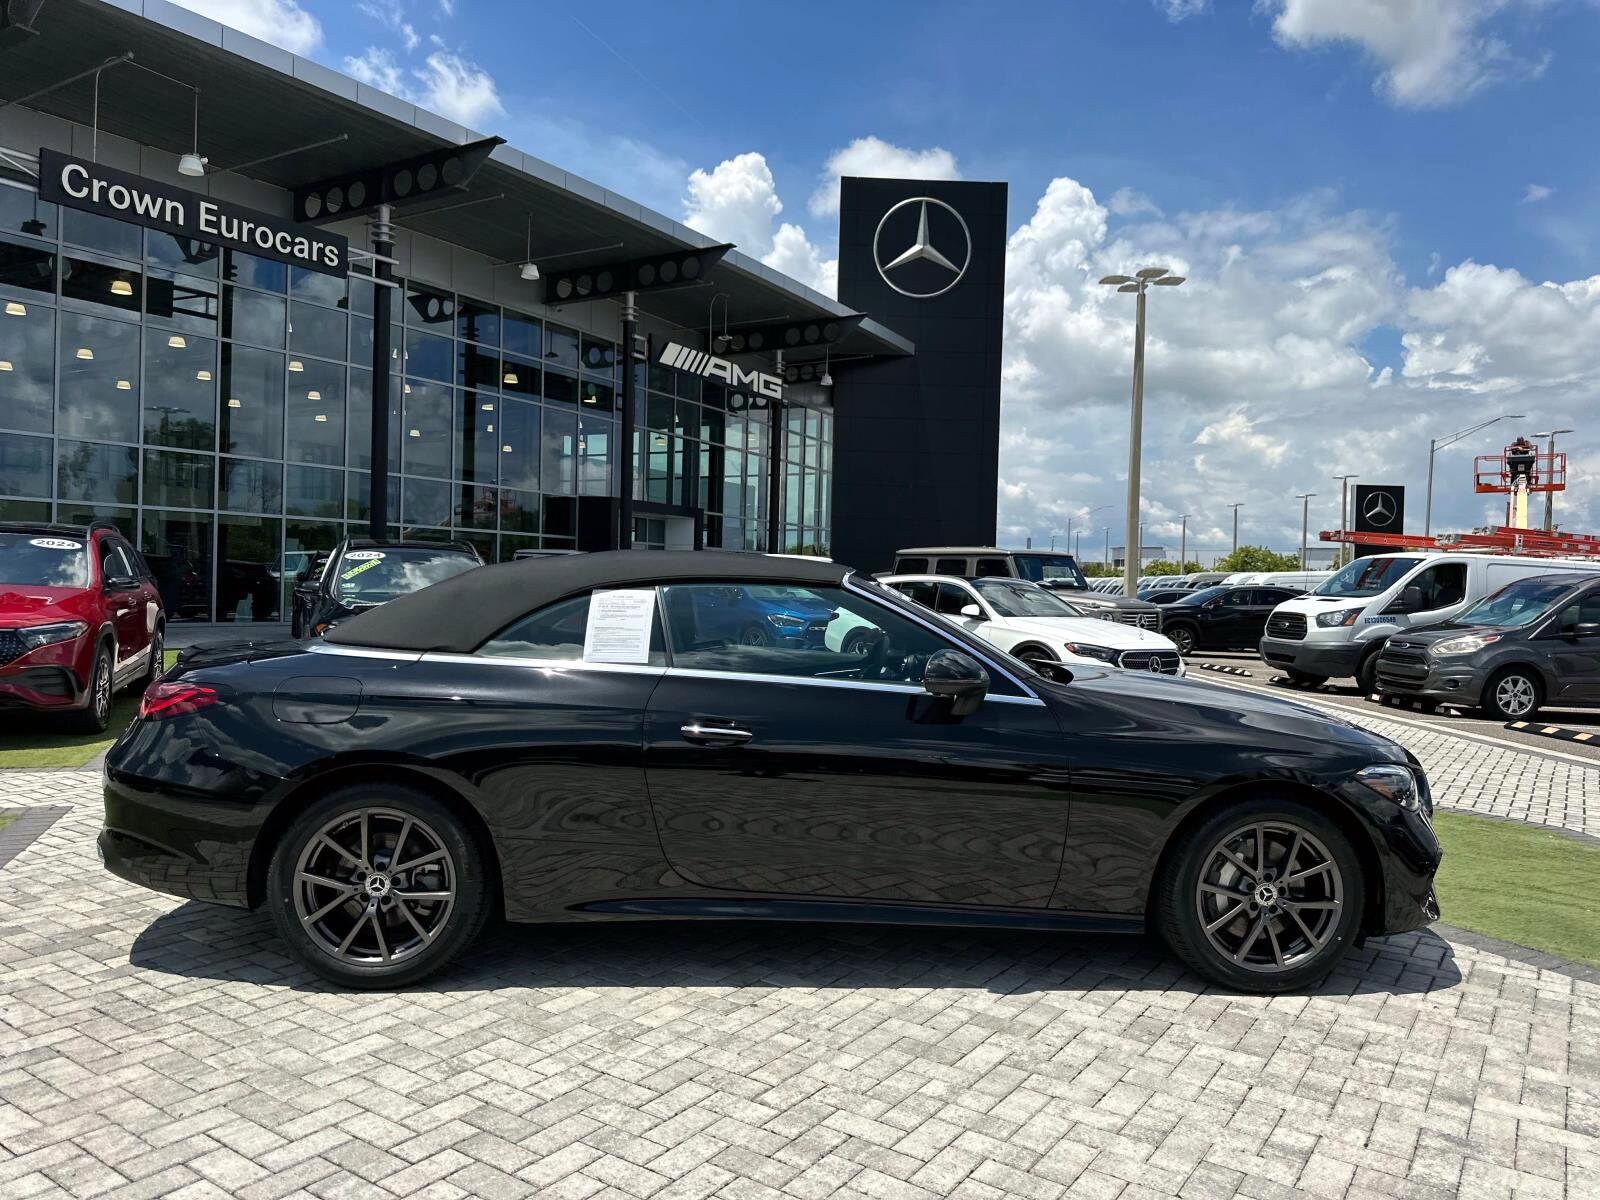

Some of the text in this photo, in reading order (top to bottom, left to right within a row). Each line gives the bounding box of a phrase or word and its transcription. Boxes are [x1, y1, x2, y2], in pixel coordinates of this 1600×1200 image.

[61, 163, 339, 267] Crown Eurocars
[702, 356, 782, 400] AMG
[36, 540, 76, 548] 2024
